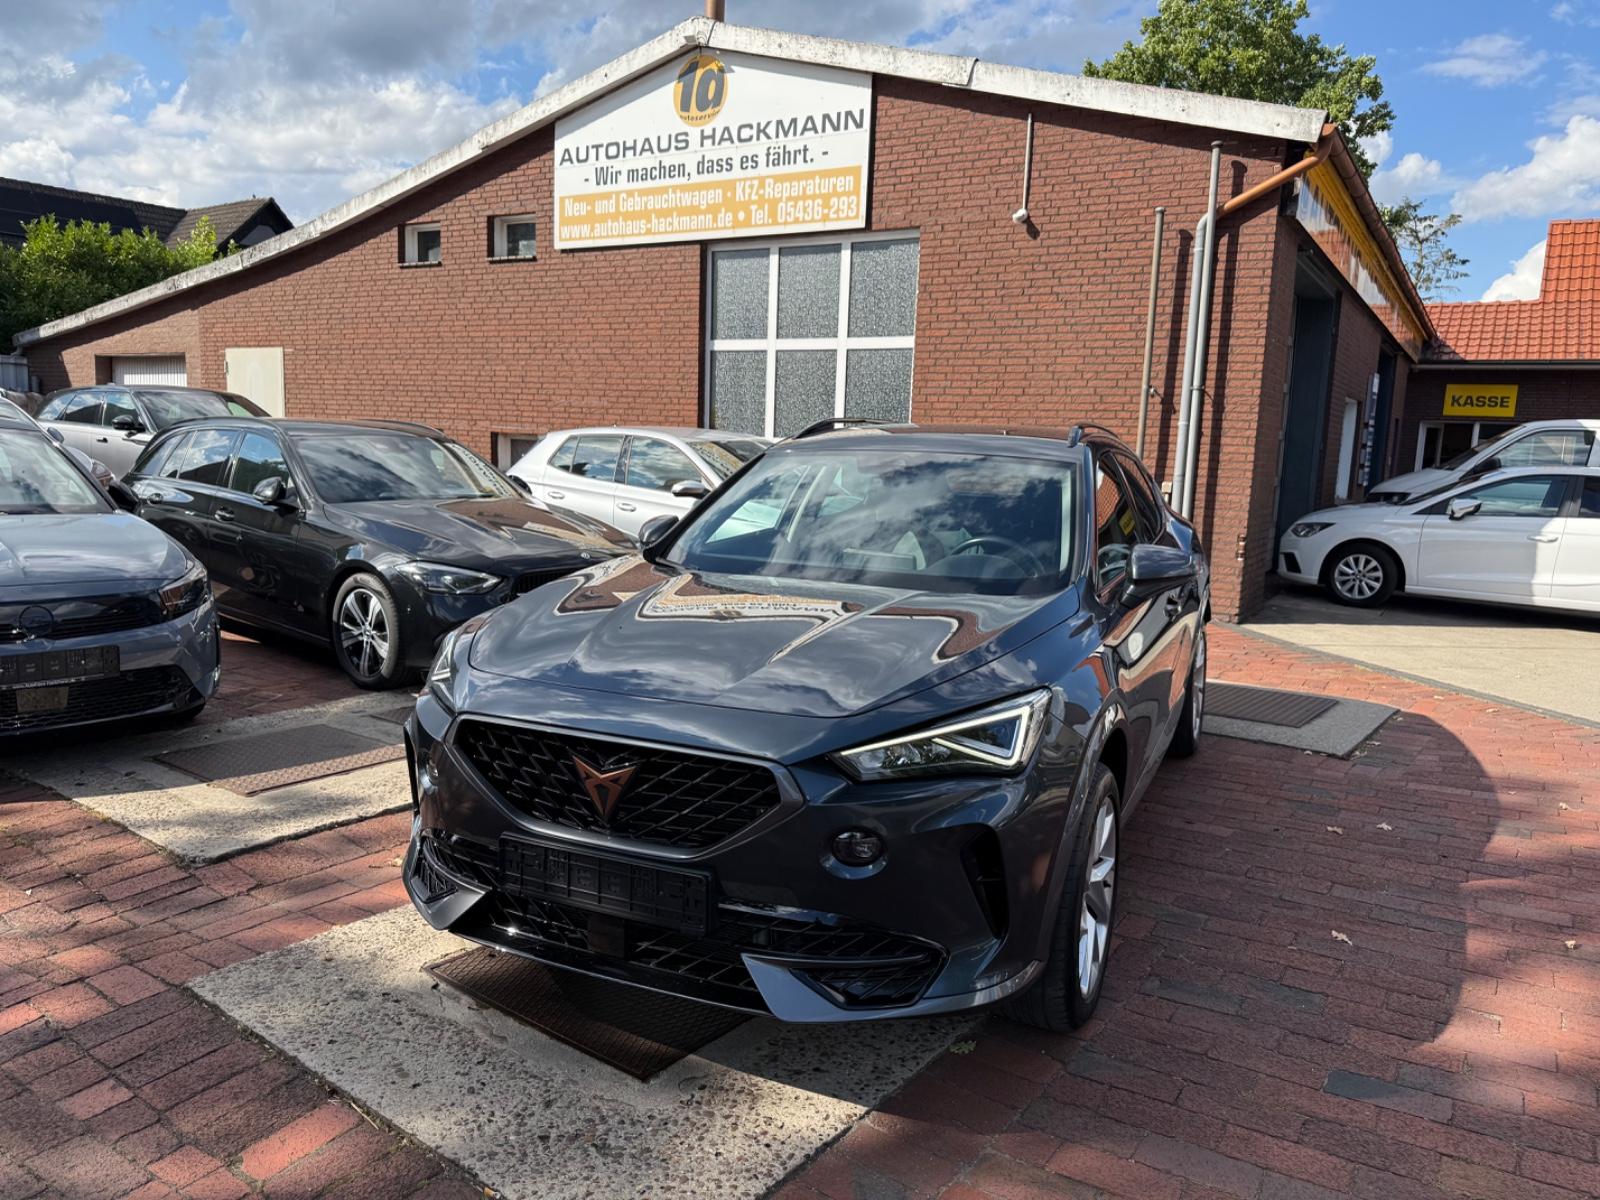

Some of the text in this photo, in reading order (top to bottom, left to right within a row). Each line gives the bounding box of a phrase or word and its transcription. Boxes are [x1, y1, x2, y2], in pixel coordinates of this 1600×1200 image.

[559, 108, 865, 166] AUTOHAUS HACKMANN
[595, 166, 622, 186] Wir
[627, 160, 691, 183] machen,
[696, 154, 733, 175] dass
[740, 153, 759, 170] es
[765, 144, 814, 168] fährt.
[564, 175, 854, 217] Neu- und Gebrauchtwagen KFZ-Reparaturen
[560, 196, 857, 240] www.autohaus-hackmann.de Tel. 05436-293
[1450, 395, 1511, 408] KASSE
